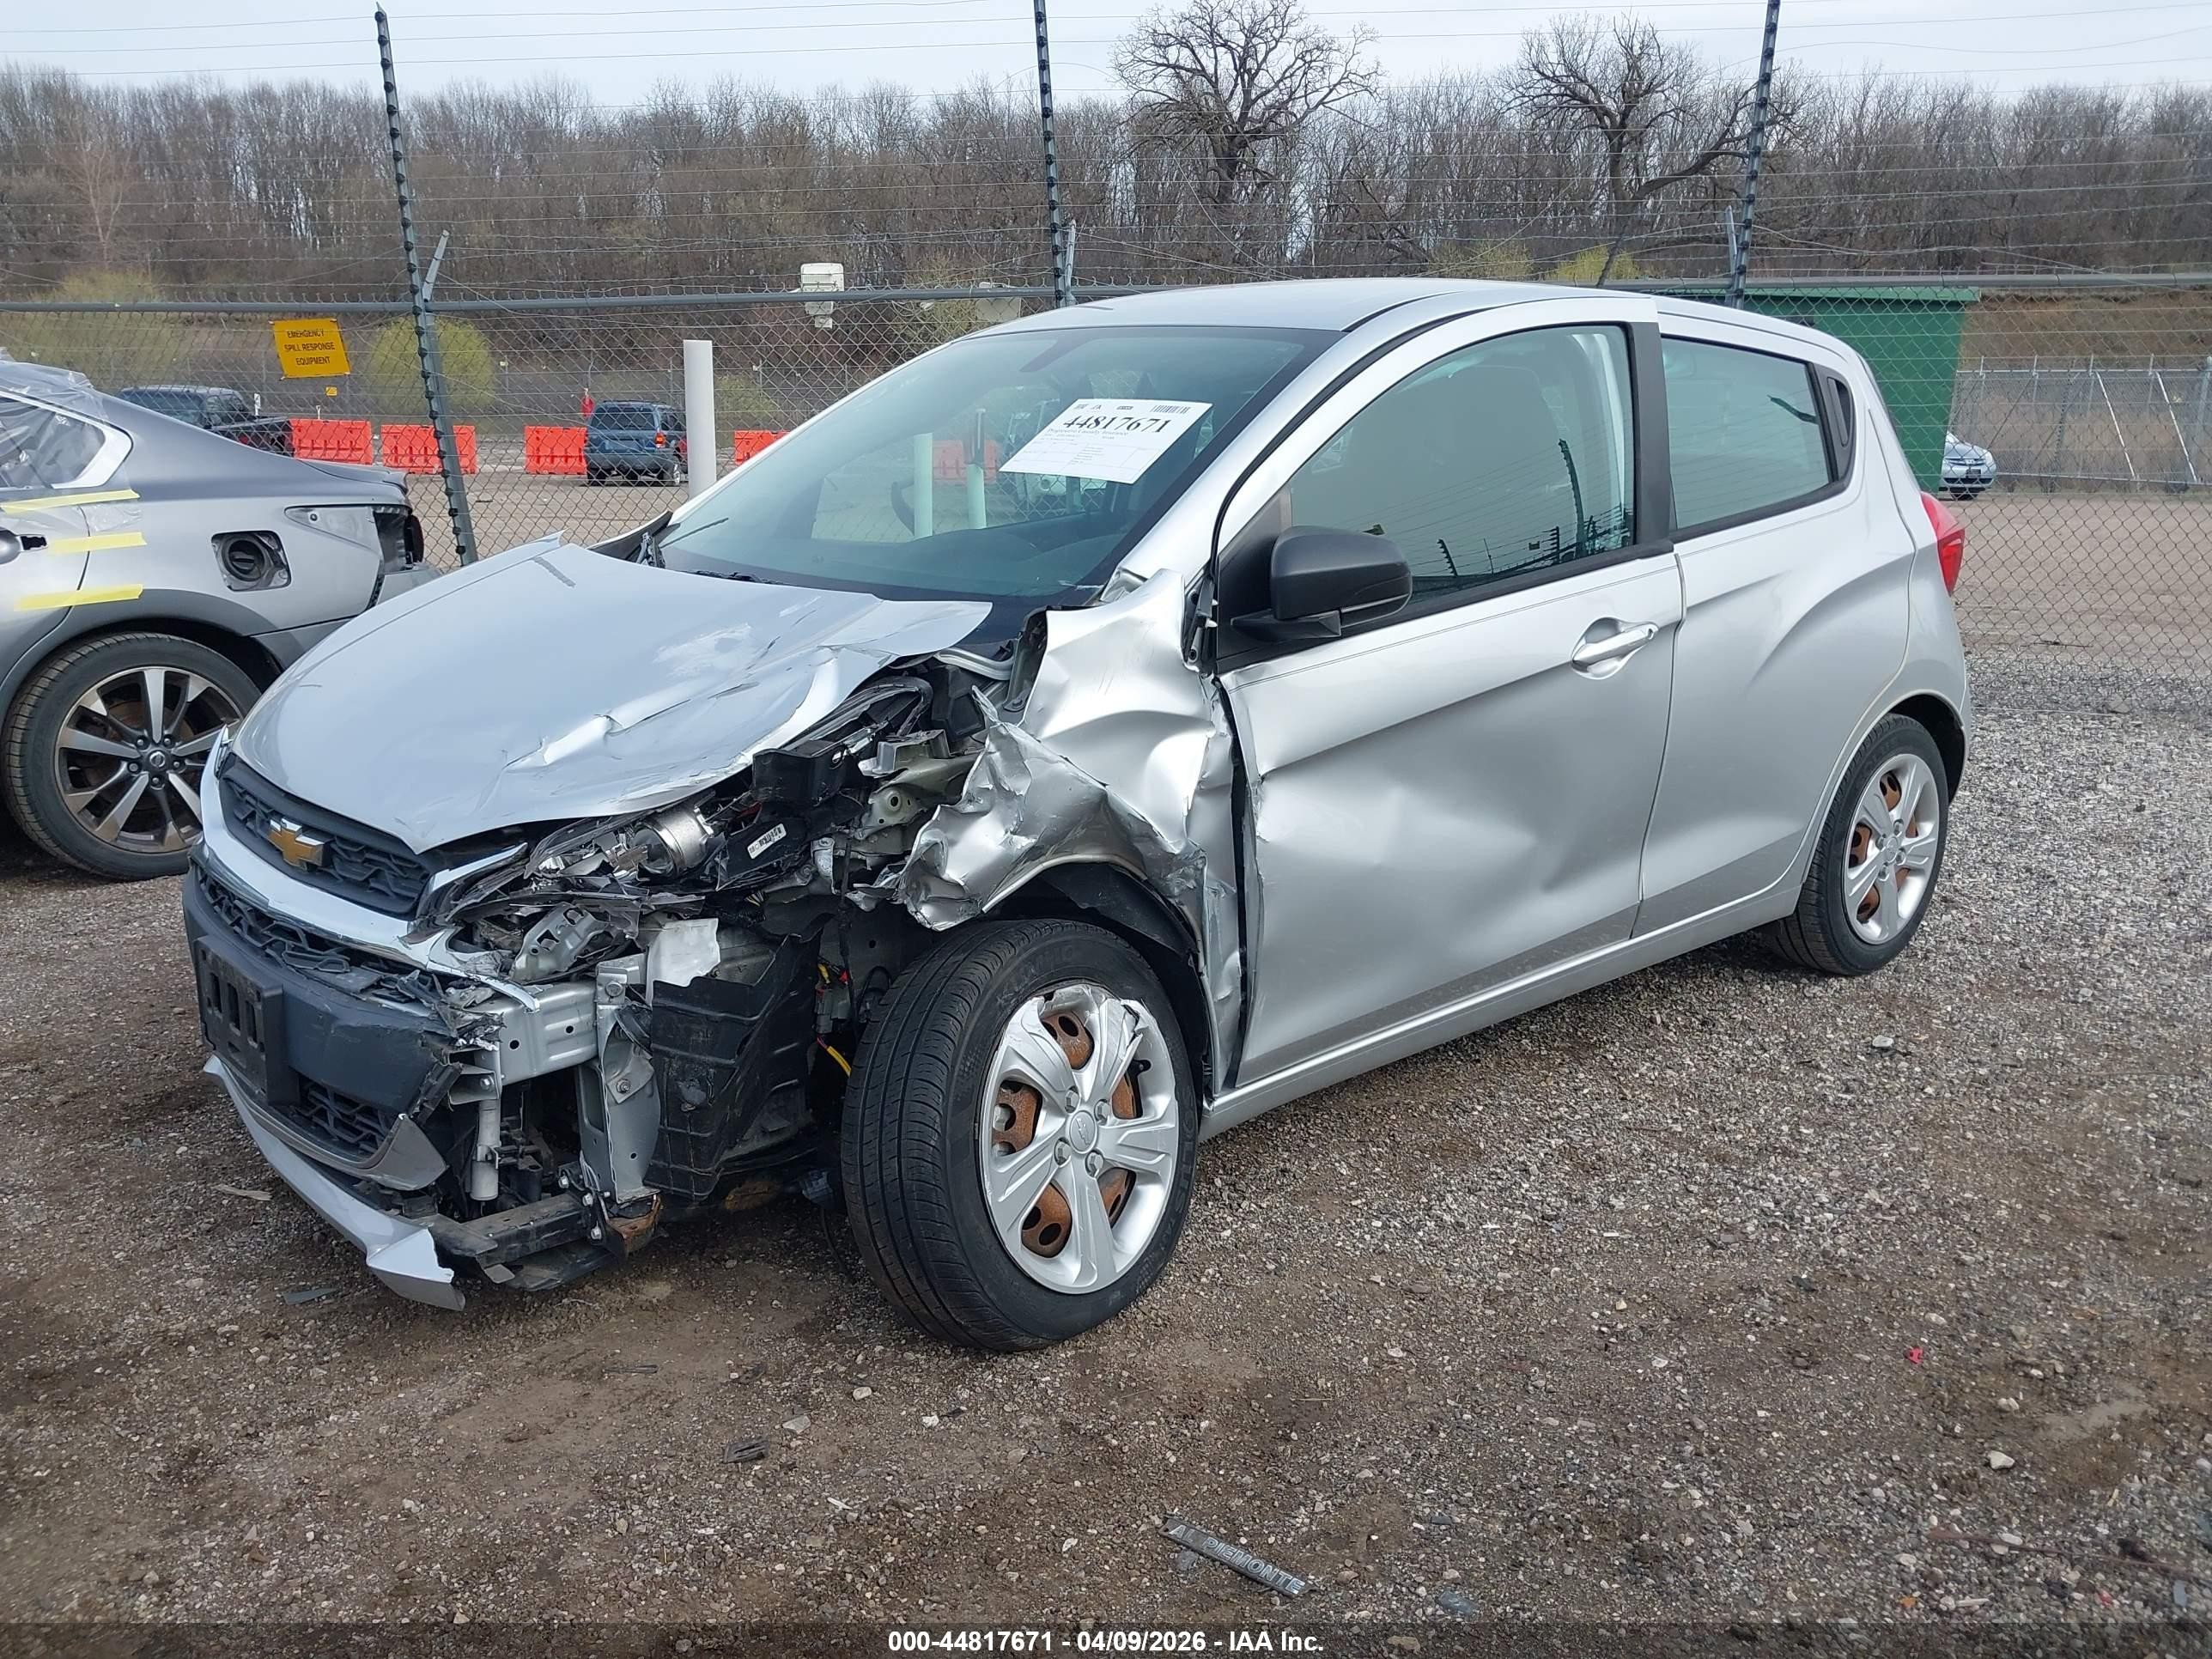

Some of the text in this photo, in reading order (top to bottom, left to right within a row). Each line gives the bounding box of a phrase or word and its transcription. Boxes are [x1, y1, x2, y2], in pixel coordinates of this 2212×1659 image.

[287, 329, 325, 338] EMERGENCY
[302, 342, 336, 351] RESPONSE
[295, 356, 331, 366] EQUIPMENT
[1063, 415, 1171, 433] 44817671
[1169, 1524, 1306, 1595] AL PIEMONTE
